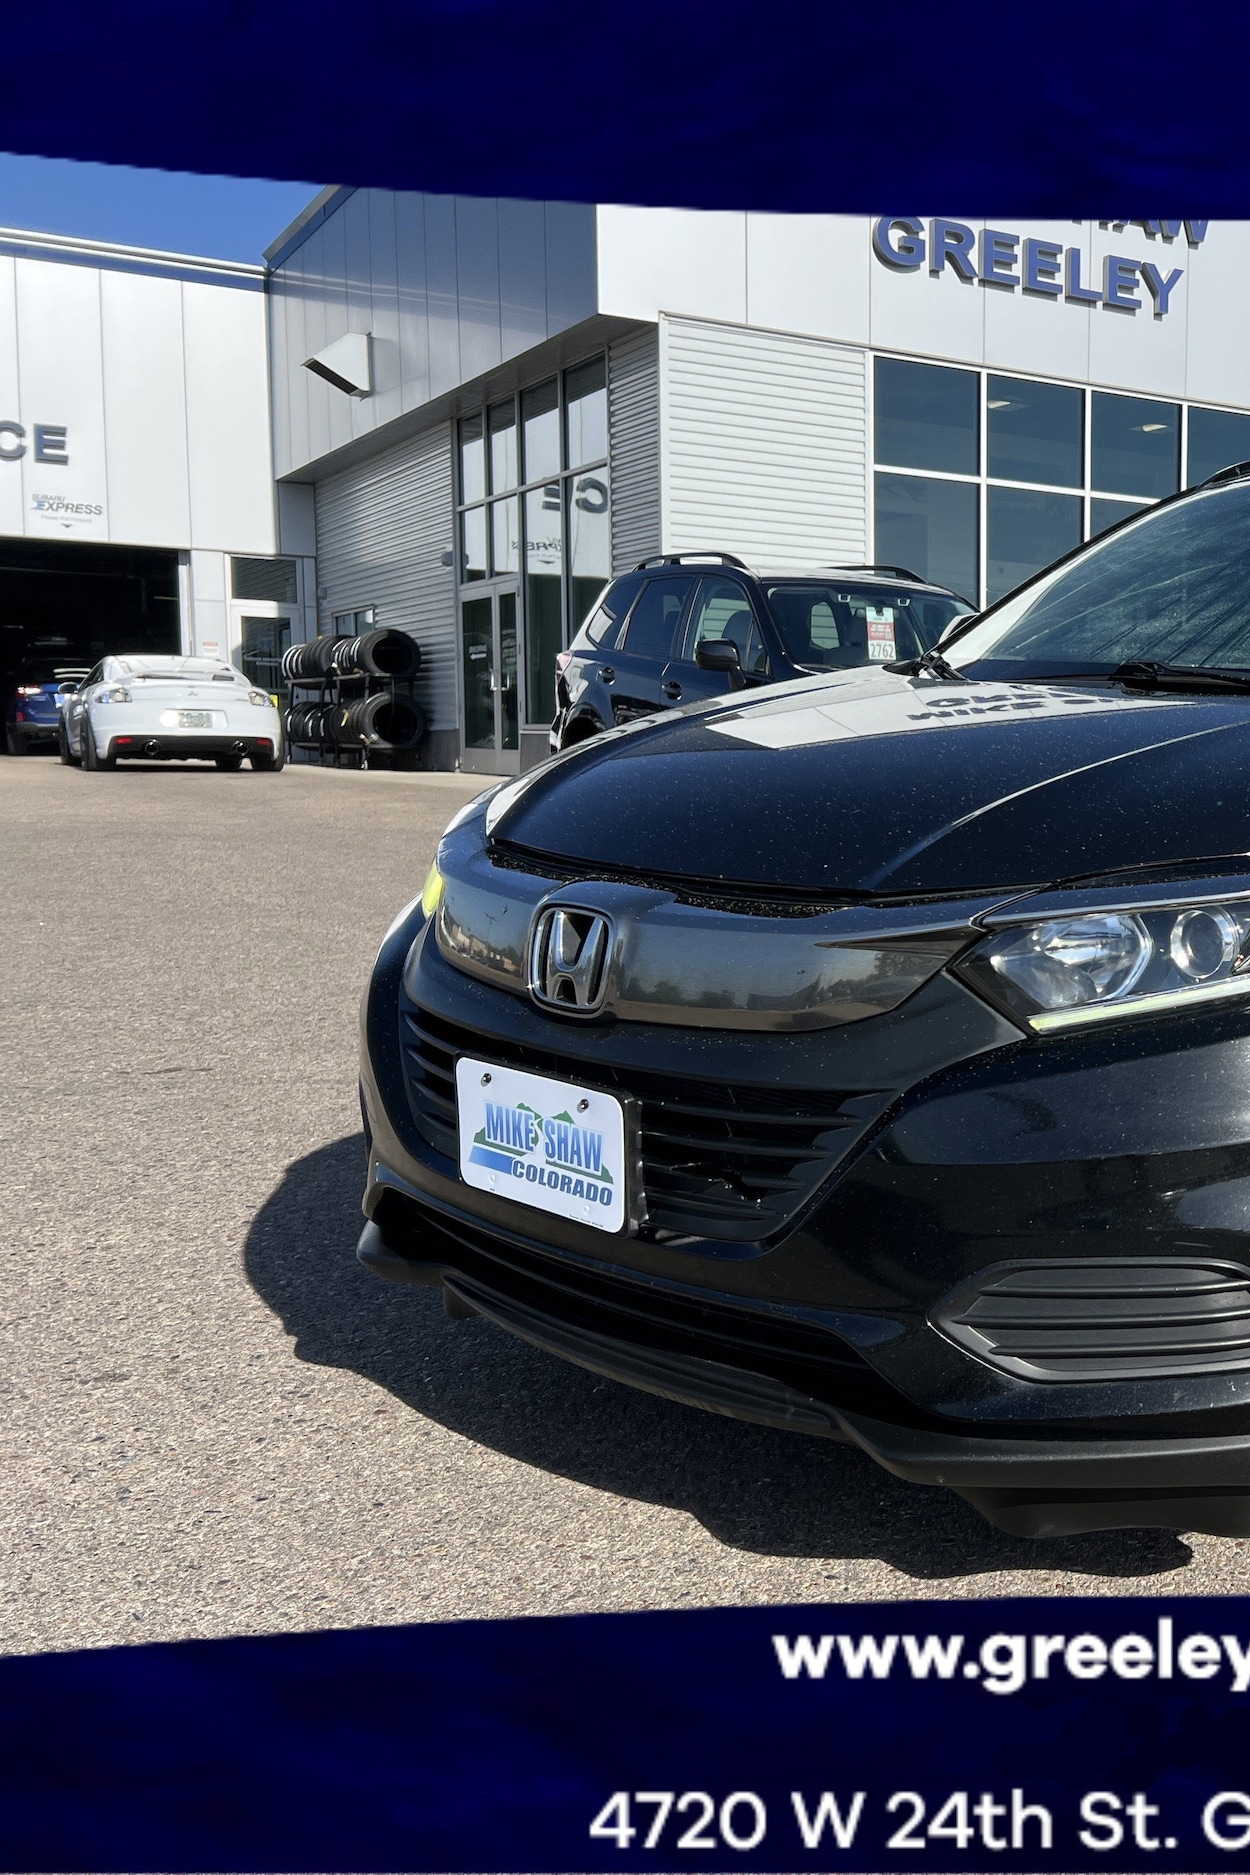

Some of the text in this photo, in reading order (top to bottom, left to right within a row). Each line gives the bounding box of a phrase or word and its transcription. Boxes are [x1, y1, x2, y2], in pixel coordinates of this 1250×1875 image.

[872, 216, 1185, 317] GREELEY
[31, 500, 103, 516] EXPRESS
[870, 643, 895, 659] 2762
[485, 1101, 603, 1173] MIKE SHAW
[512, 1160, 613, 1207] COLORADO
